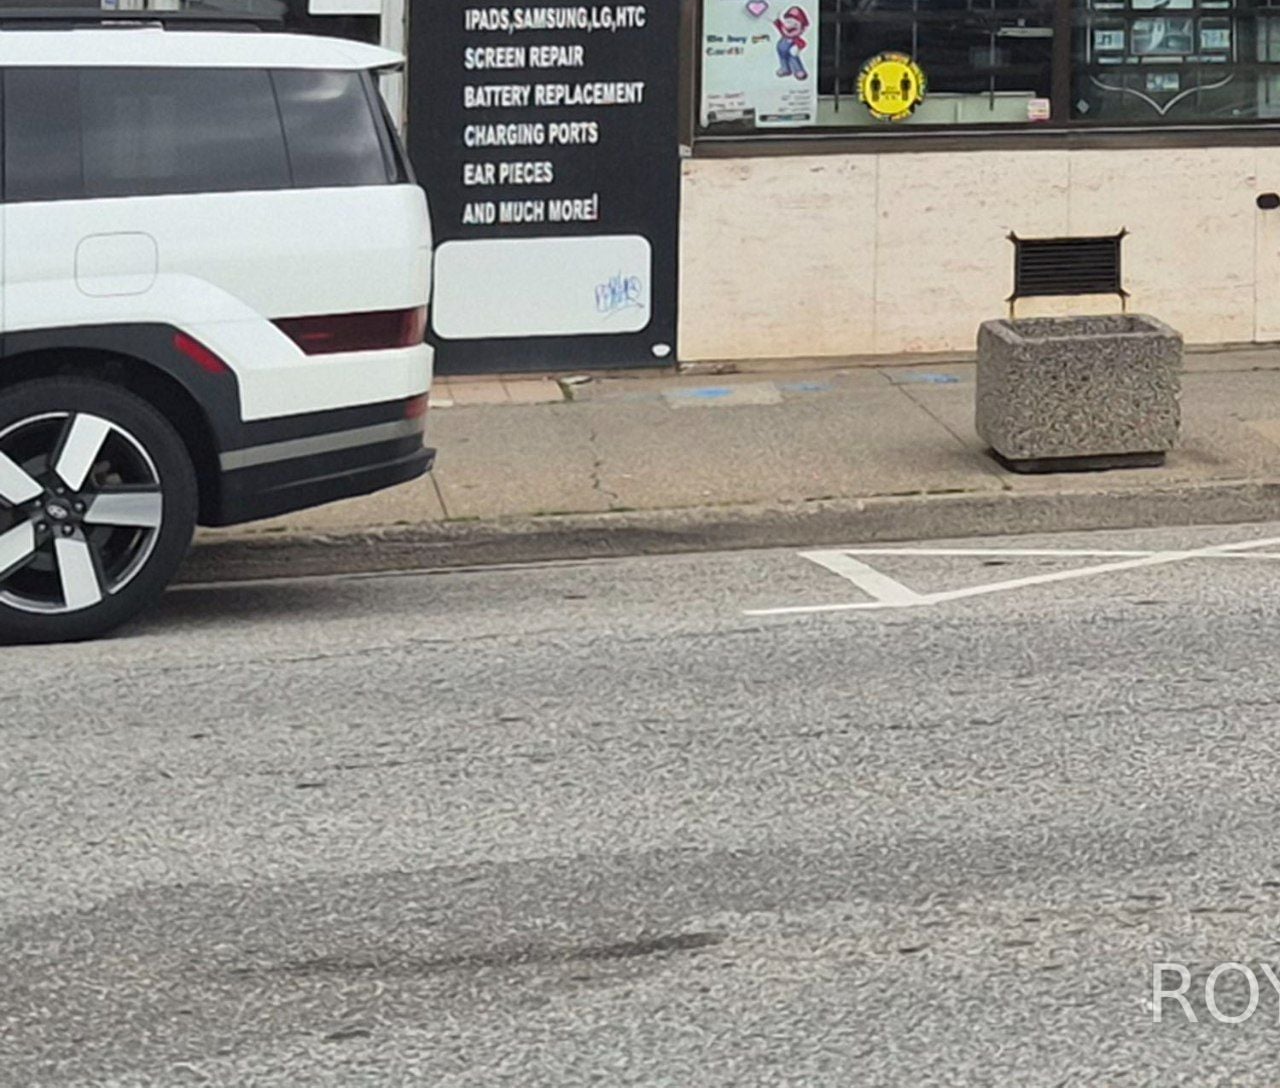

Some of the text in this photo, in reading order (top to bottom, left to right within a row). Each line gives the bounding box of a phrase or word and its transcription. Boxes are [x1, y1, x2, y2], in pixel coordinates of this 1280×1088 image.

[465, 7, 646, 34] IPADS,SAMSUNG,LG,HTC
[464, 45, 584, 69] SCREEN REPAIR
[464, 82, 644, 108] BATTERY REPLACEMENT
[464, 121, 598, 146] CHARGING PORTS
[463, 162, 553, 185] EAR PIECES
[463, 193, 598, 225] AND MUCH MORE!
